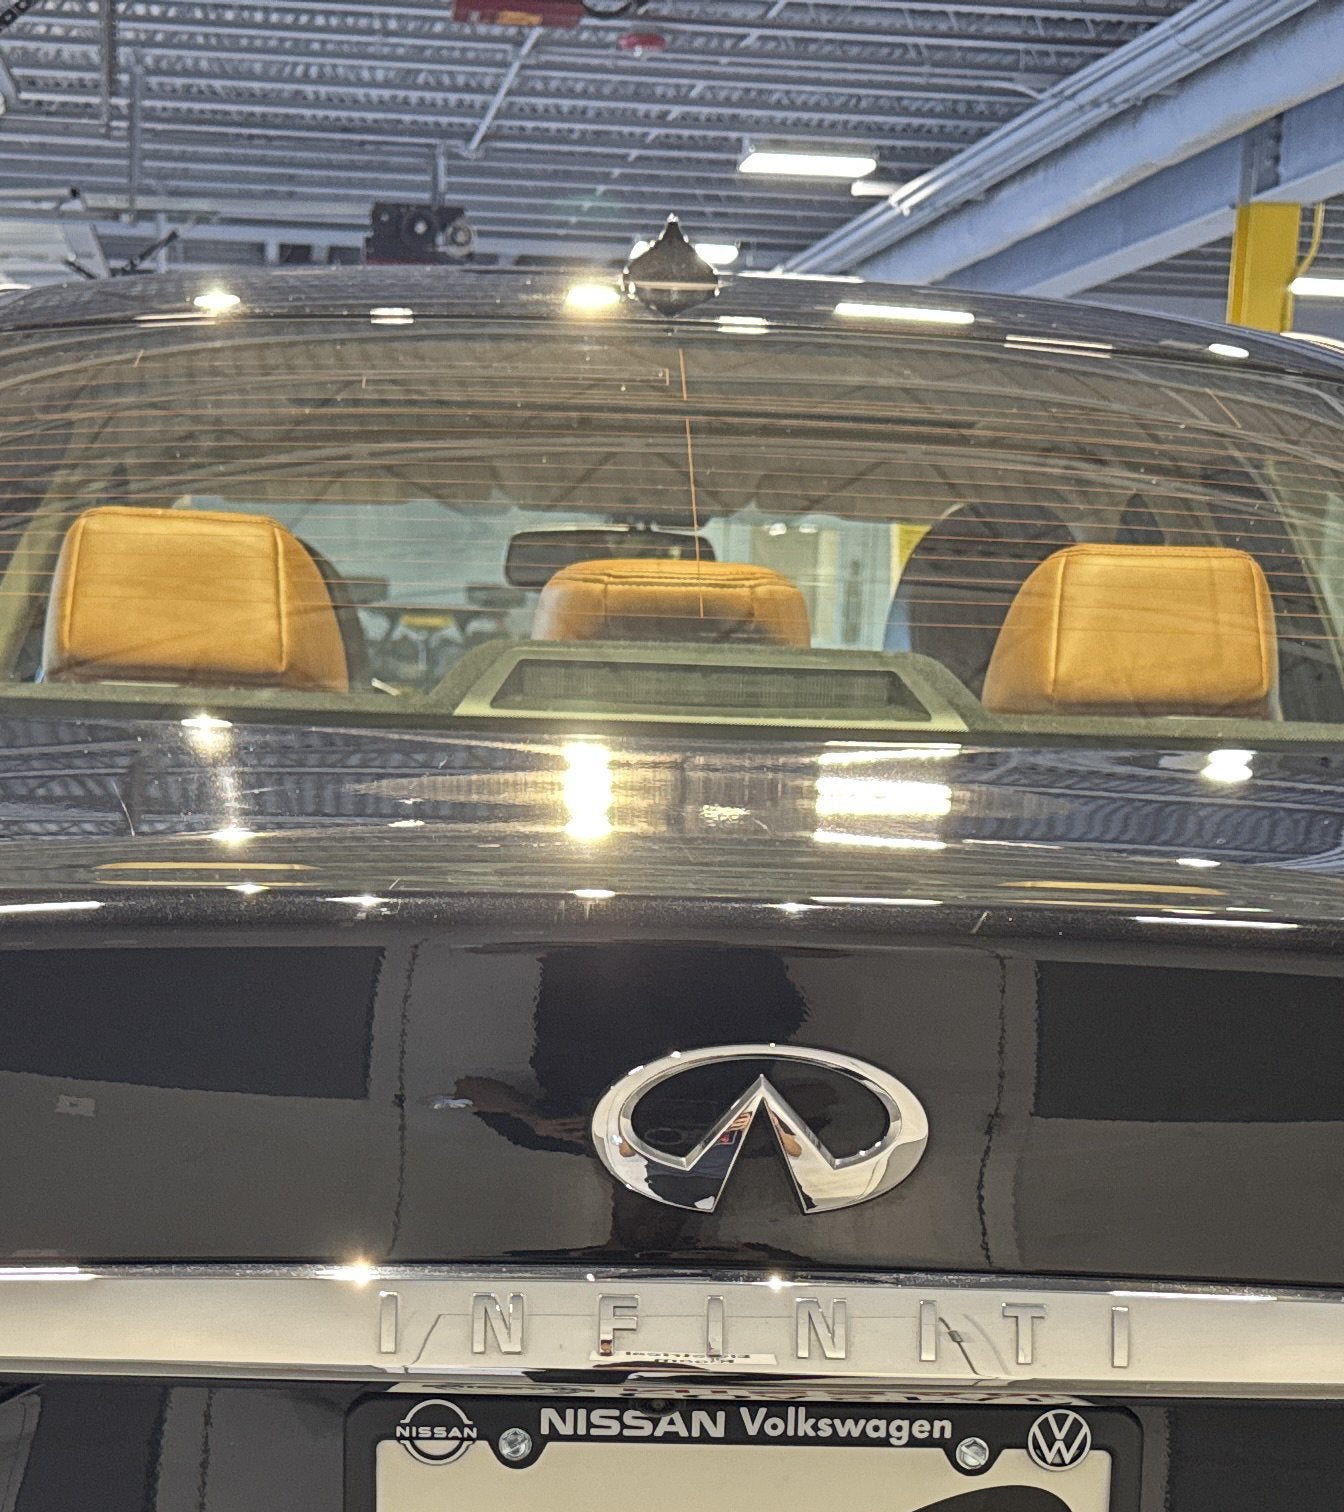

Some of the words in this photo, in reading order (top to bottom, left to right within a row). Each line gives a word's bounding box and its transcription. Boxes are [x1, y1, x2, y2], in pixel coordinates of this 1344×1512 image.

[377, 1290, 1131, 1370] INFINITI
[394, 1424, 479, 1442] NISSAN
[539, 1406, 727, 1440] NISSAN
[739, 1406, 953, 1446] Volkswagen
